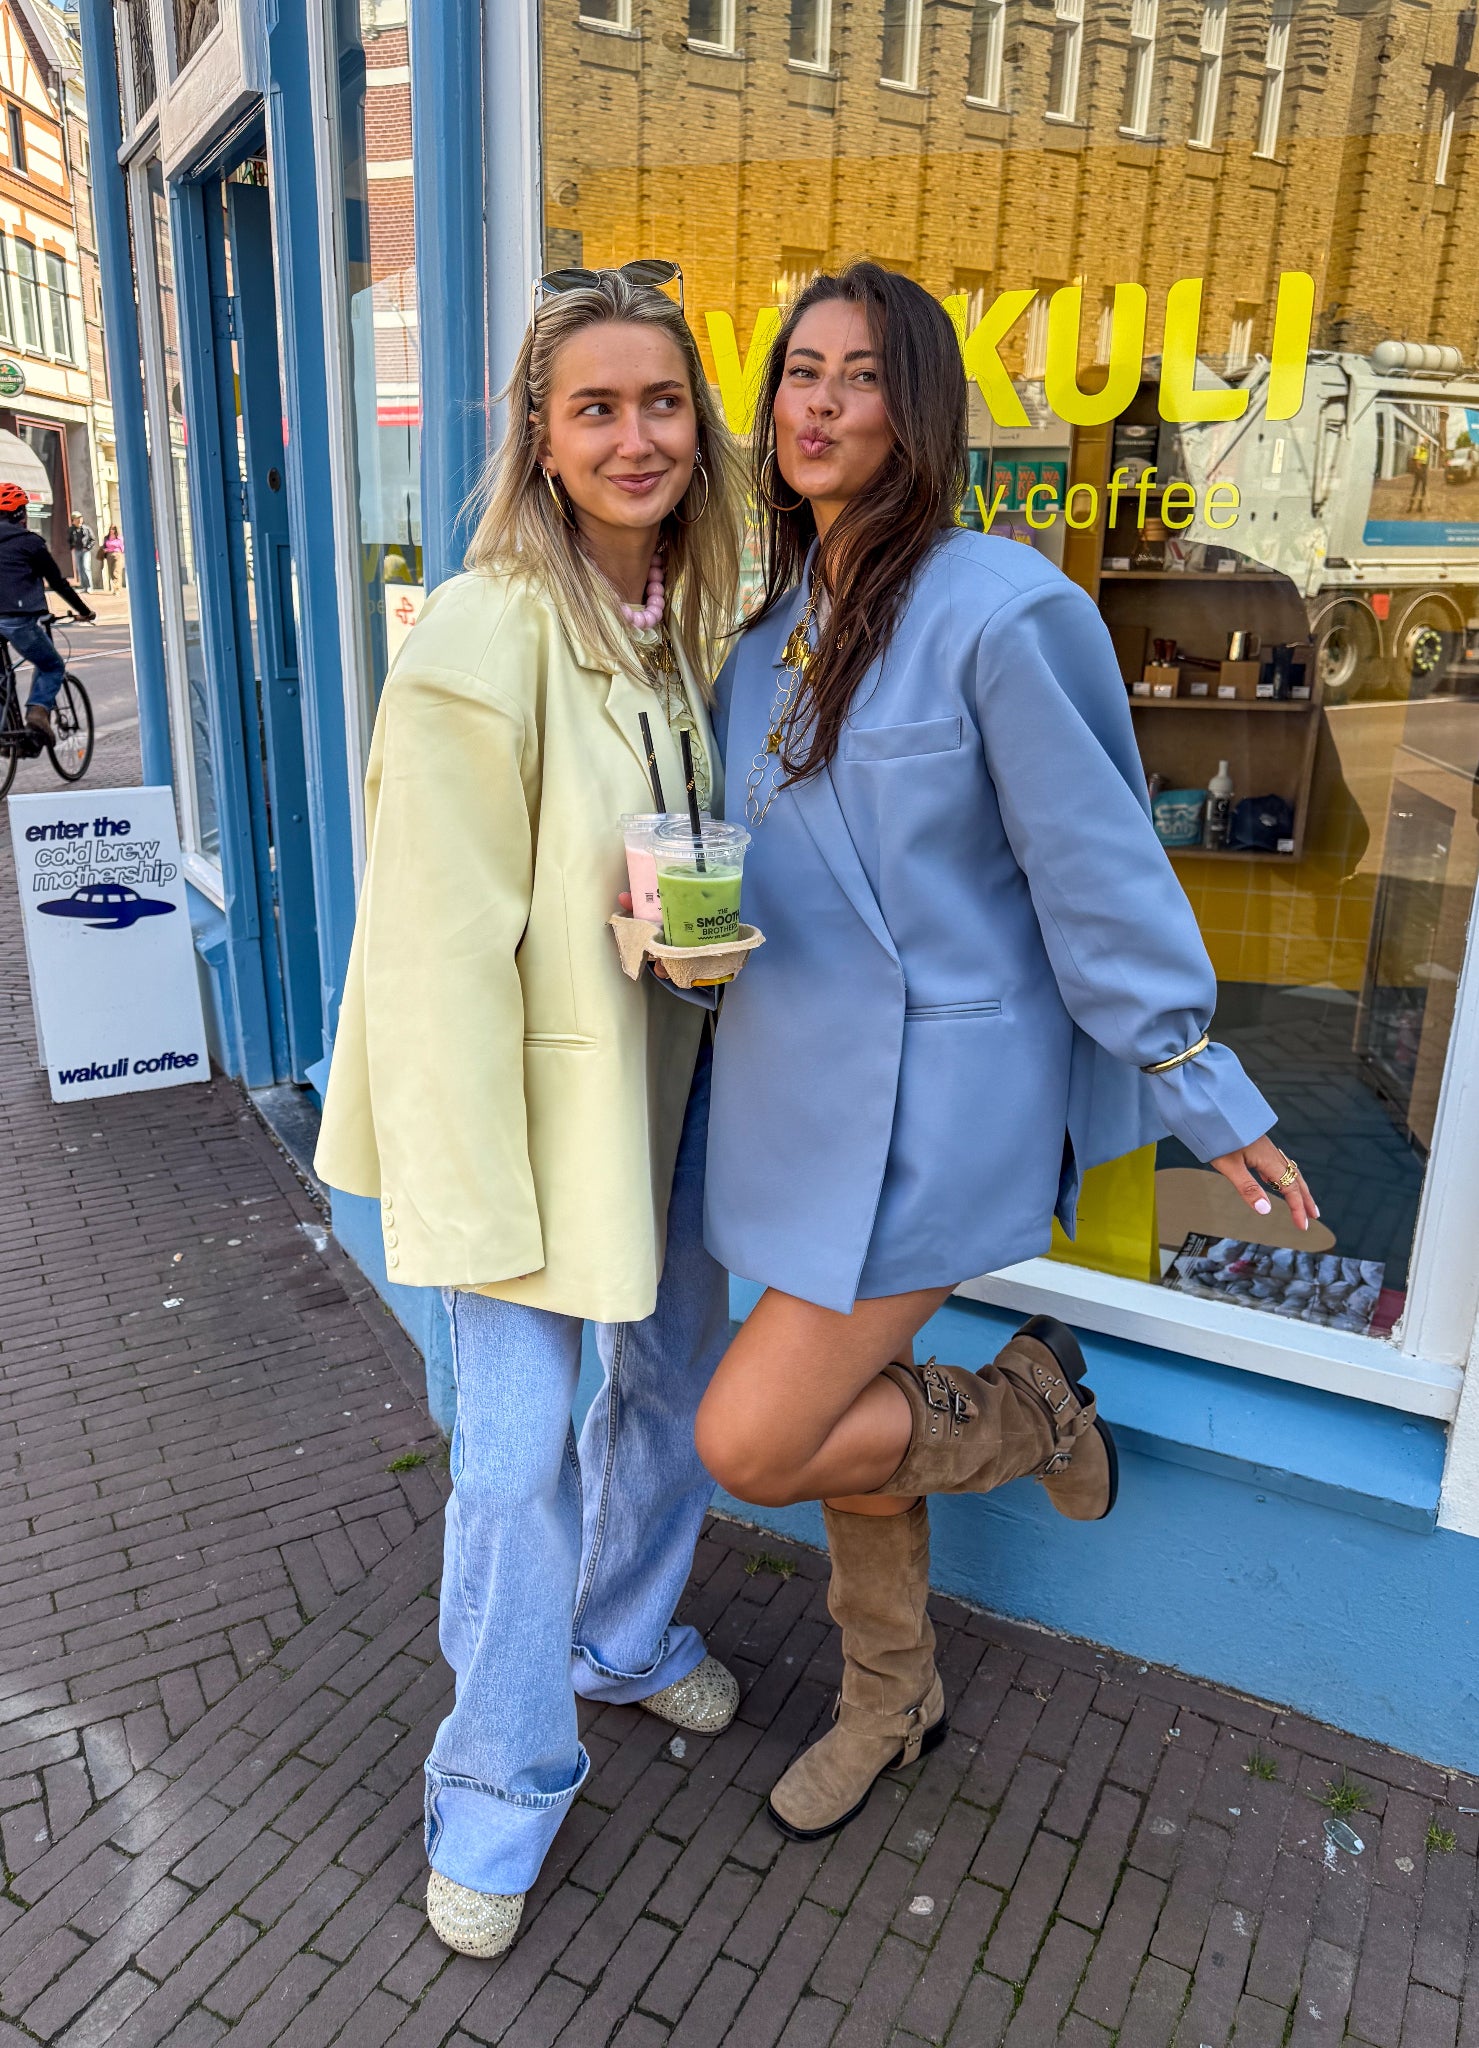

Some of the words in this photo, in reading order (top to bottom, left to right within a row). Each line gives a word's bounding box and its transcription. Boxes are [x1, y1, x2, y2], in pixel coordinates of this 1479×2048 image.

[1025, 467, 1241, 530] coffee
[25, 821, 89, 842] enter
[93, 817, 131, 837] the
[35, 840, 92, 868] cold
[96, 840, 160, 863] brew
[33, 859, 177, 892] mothership
[717, 907, 729, 915] THE
[58, 1058, 129, 1085] wakuli
[133, 1051, 199, 1075] coffee
